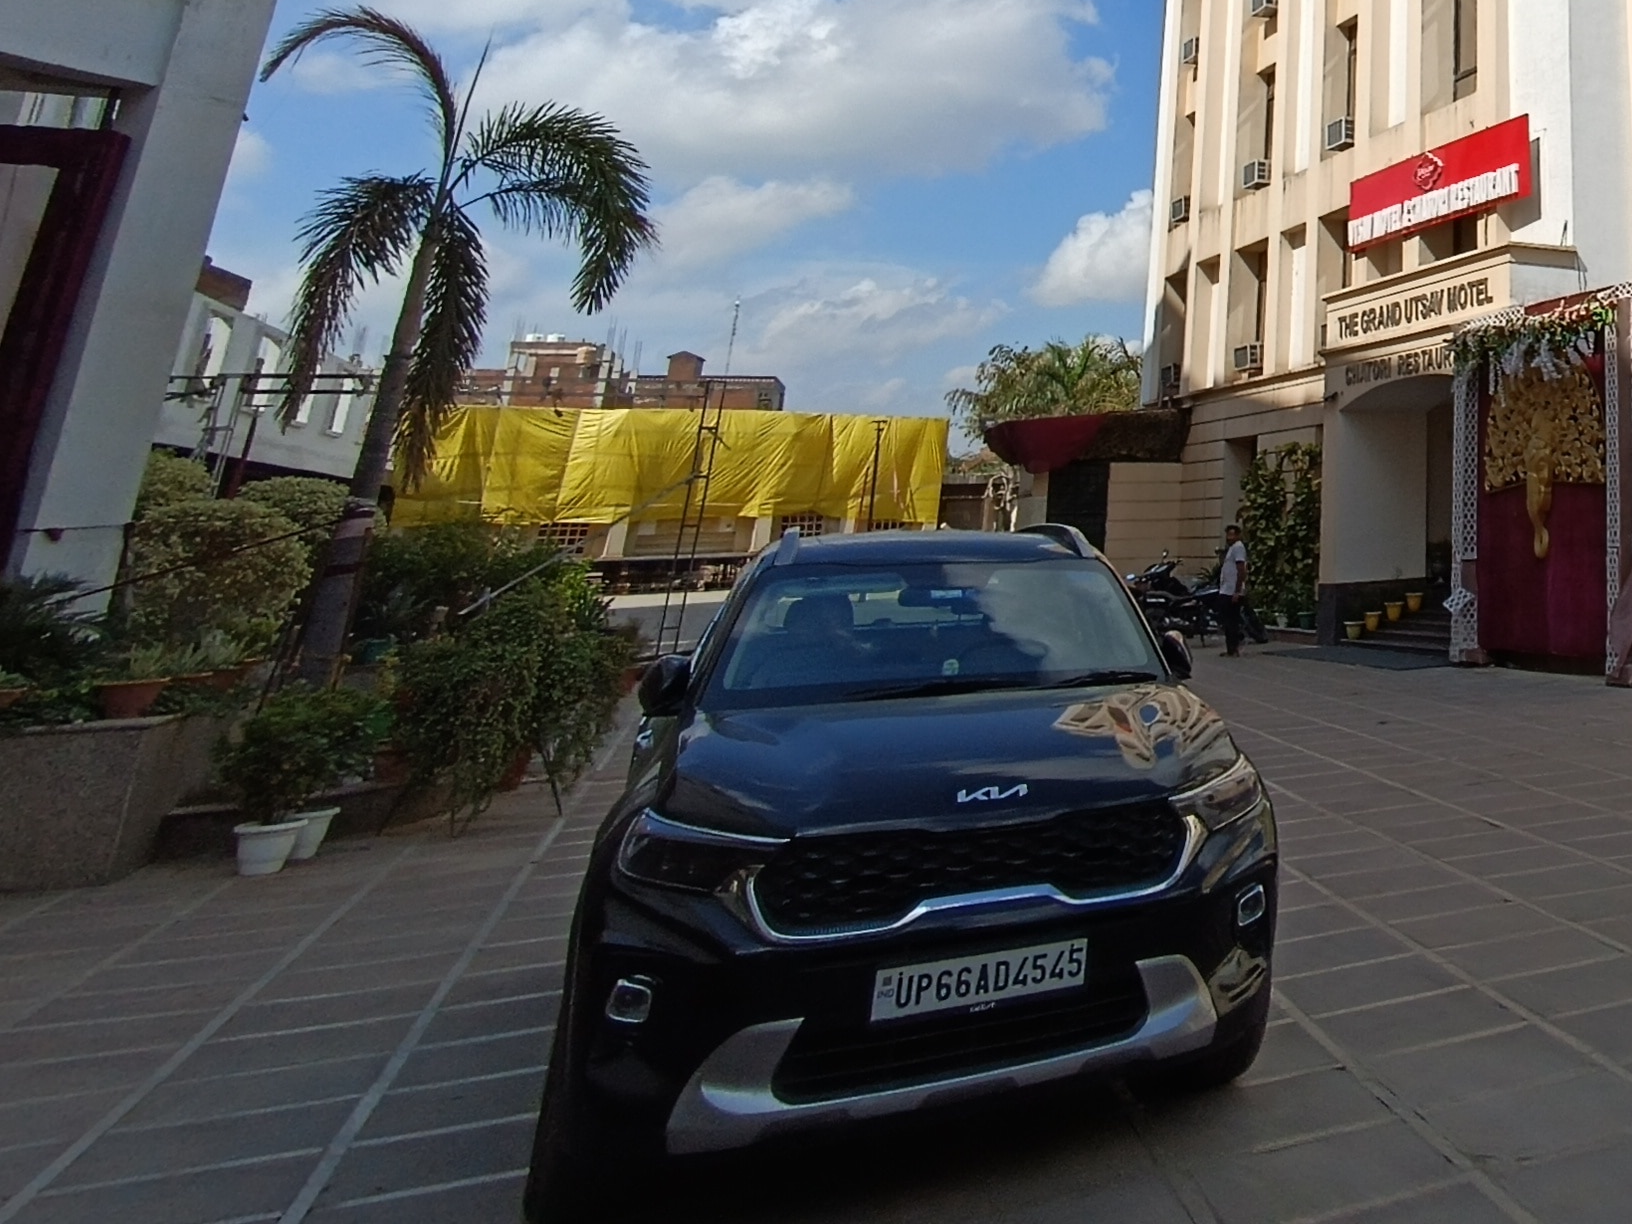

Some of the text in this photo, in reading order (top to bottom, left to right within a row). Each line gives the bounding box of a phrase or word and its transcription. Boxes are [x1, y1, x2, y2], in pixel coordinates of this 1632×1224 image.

[1449, 163, 1519, 211] RESTAURANT
[1338, 277, 1493, 340] THE GRAND UTSAV MOTEL
[1397, 346, 1453, 375] RESTAUR
[957, 783, 1028, 802] KIA
[895, 946, 1084, 1009] UP66AD4545
